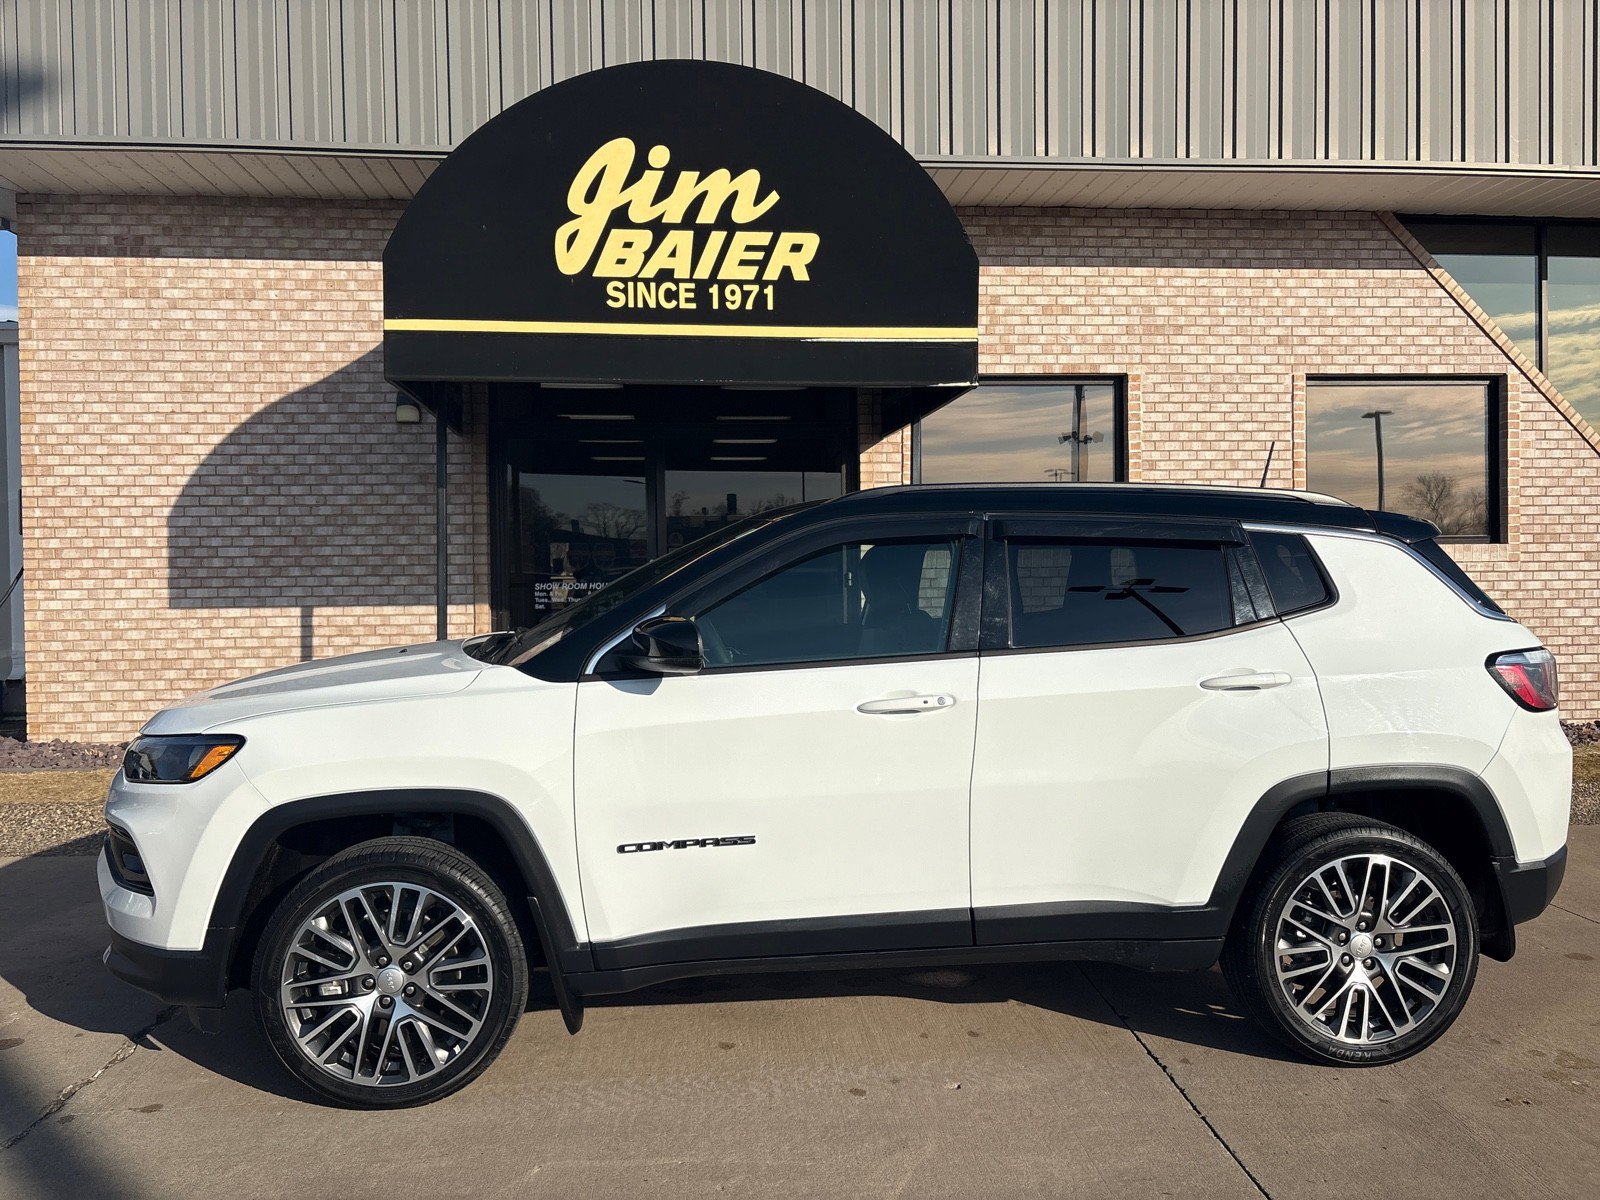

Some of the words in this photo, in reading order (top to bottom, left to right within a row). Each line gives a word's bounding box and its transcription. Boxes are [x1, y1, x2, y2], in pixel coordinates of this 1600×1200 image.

[555, 137, 780, 275] Jim
[592, 228, 820, 281] BAIER
[606, 281, 697, 309] SINCE
[708, 283, 774, 310] 1971
[534, 582, 560, 591] SHOW
[561, 582, 588, 590] ROOM
[616, 835, 756, 854] COMPASS
[1327, 1045, 1372, 1062] KENDA
